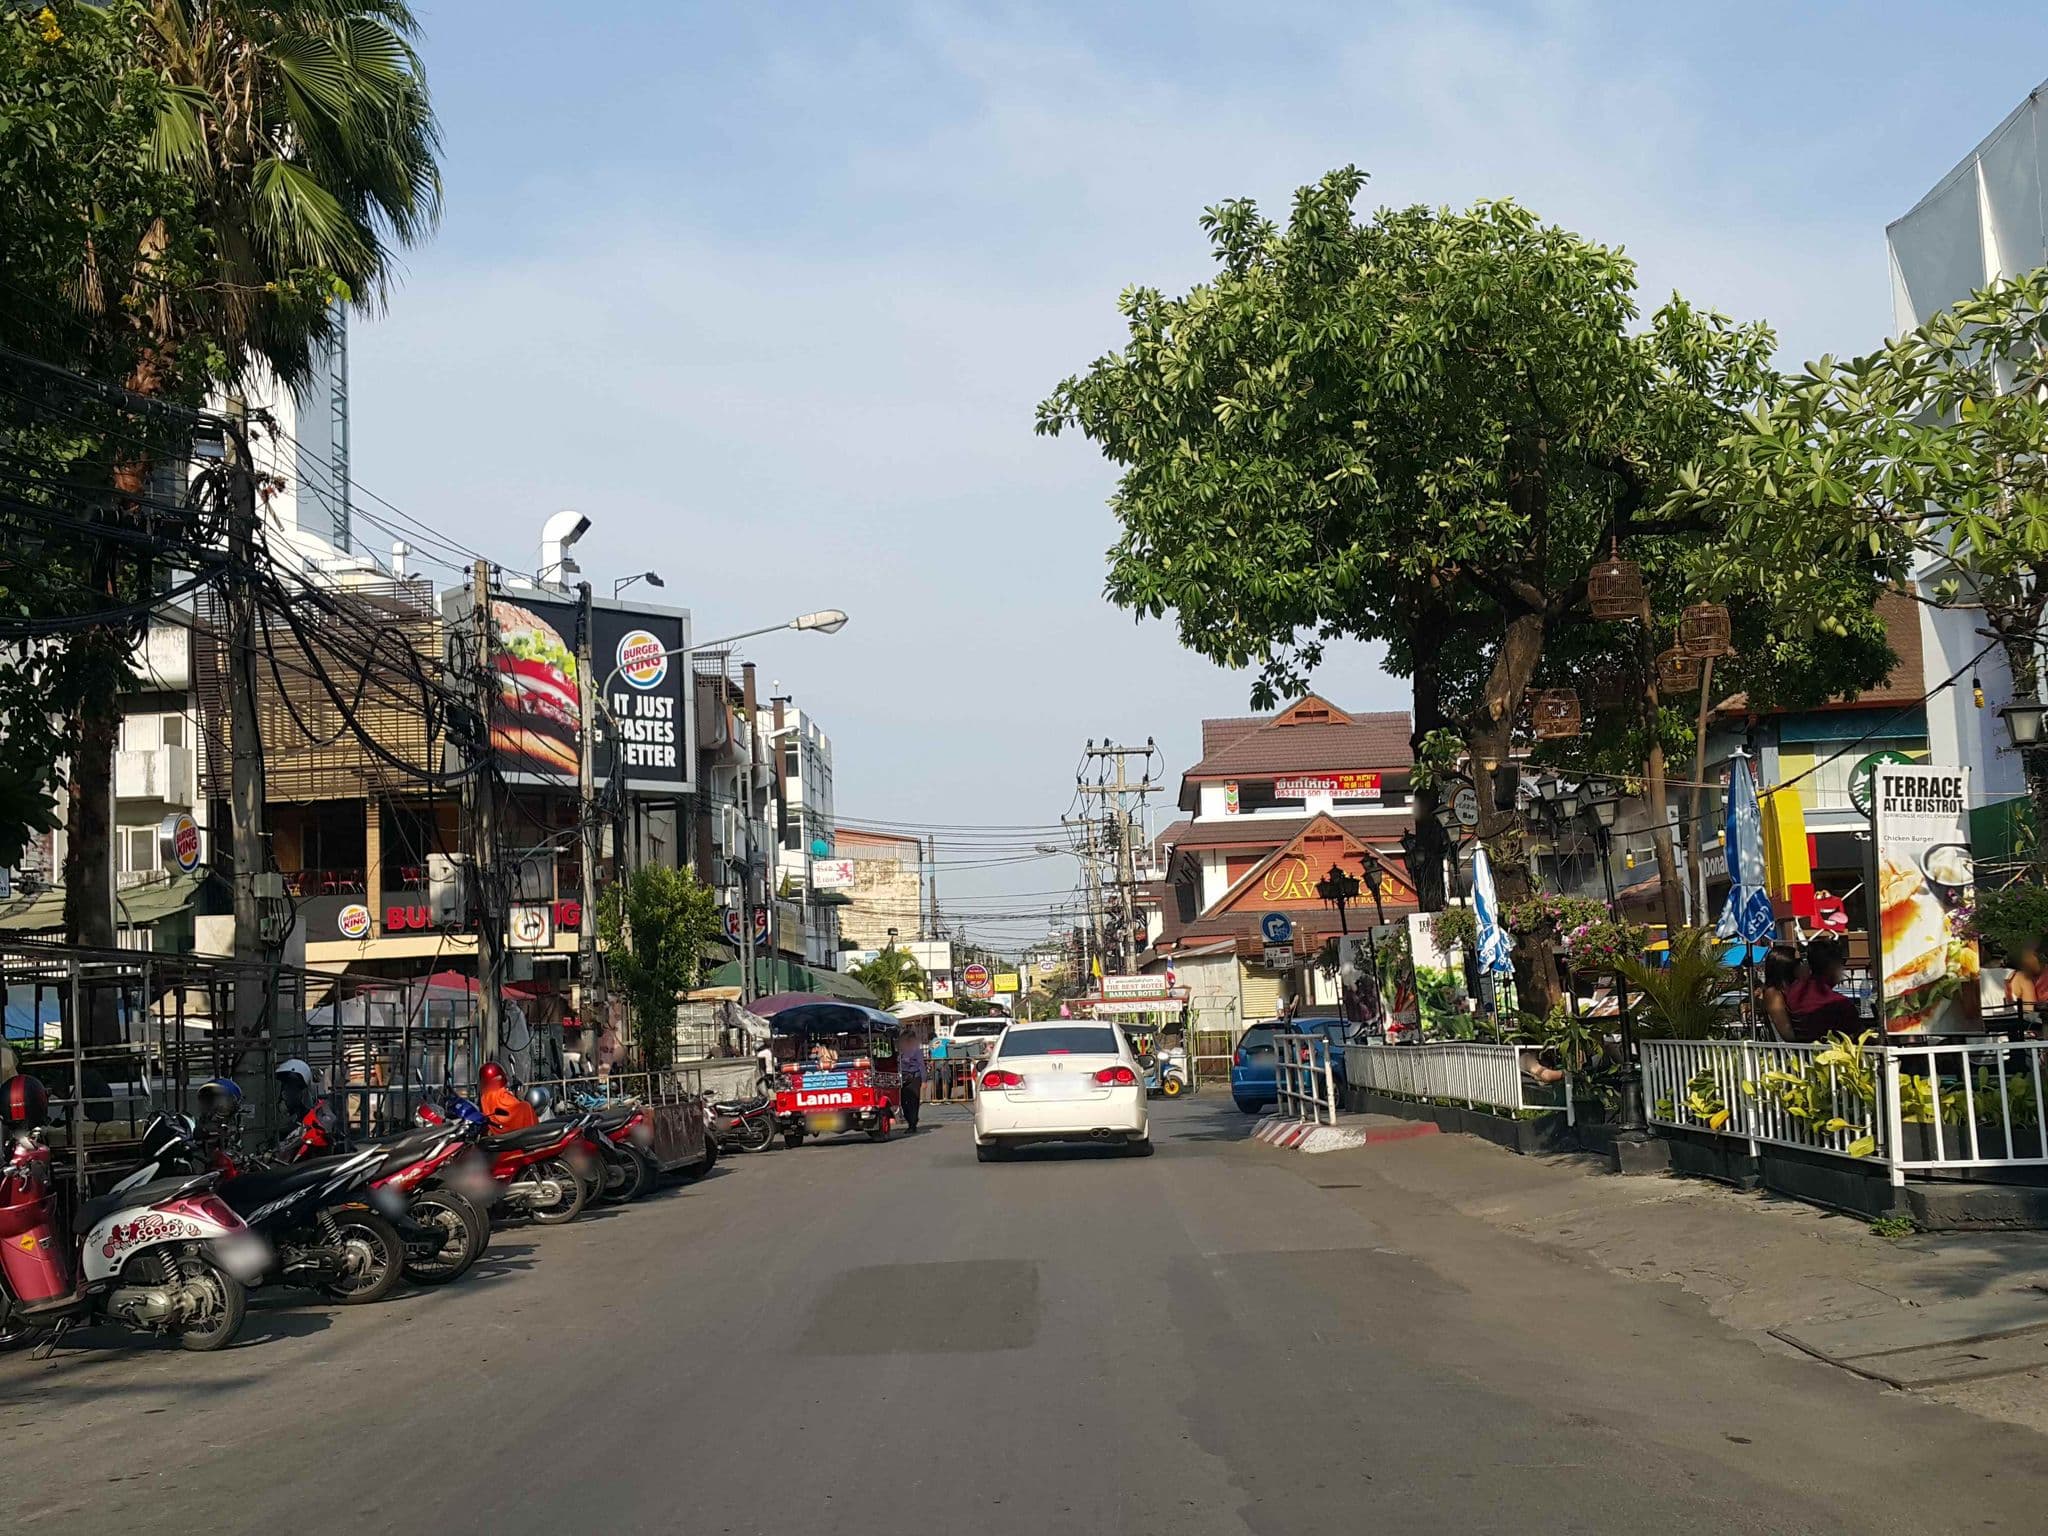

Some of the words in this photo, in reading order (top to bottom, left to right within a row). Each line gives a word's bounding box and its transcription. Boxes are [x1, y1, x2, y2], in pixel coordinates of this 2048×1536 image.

[623, 643, 660, 661] BURGER
[624, 655, 662, 675] KING
[614, 693, 630, 715] IT
[635, 695, 674, 718] JUST
[1883, 776, 1962, 798] TERRACE
[1884, 798, 1898, 811] AT
[1901, 799, 1912, 812] LE
[1915, 799, 1964, 813] BISTROT
[176, 827, 196, 845] BURGER
[1911, 835, 1935, 843] Burger
[177, 836, 198, 856] KING
[342, 911, 365, 922] BURGER
[343, 917, 366, 930] KING
[796, 1092, 853, 1107] Lanna
[138, 1224, 182, 1239] SCOOPY
